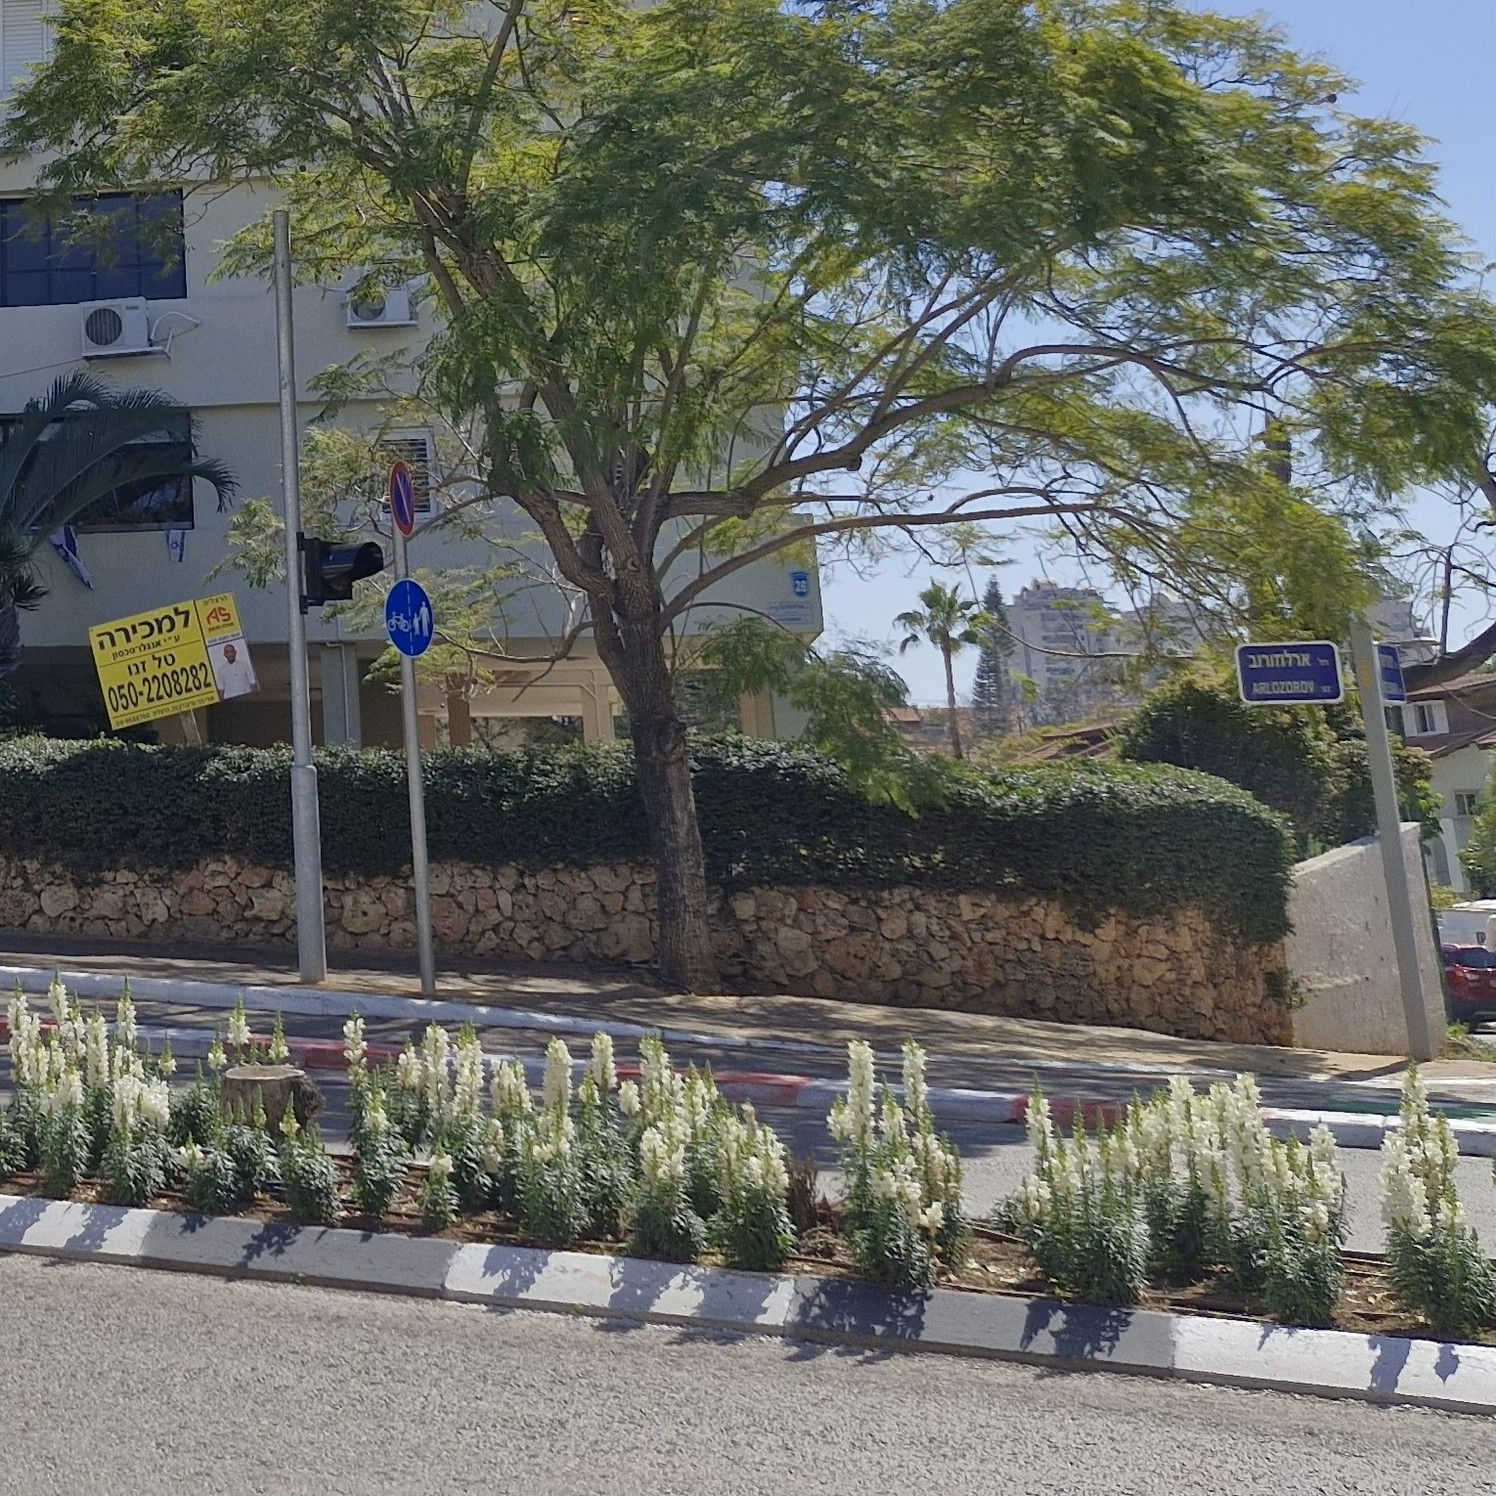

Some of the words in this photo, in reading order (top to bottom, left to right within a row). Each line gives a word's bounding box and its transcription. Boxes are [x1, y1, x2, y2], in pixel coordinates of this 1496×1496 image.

[206, 606, 231, 625] AS
[96, 606, 190, 651] למכירה
[127, 662, 147, 676] זנו
[152, 652, 176, 669] טל
[108, 662, 212, 713] 050-2208282
